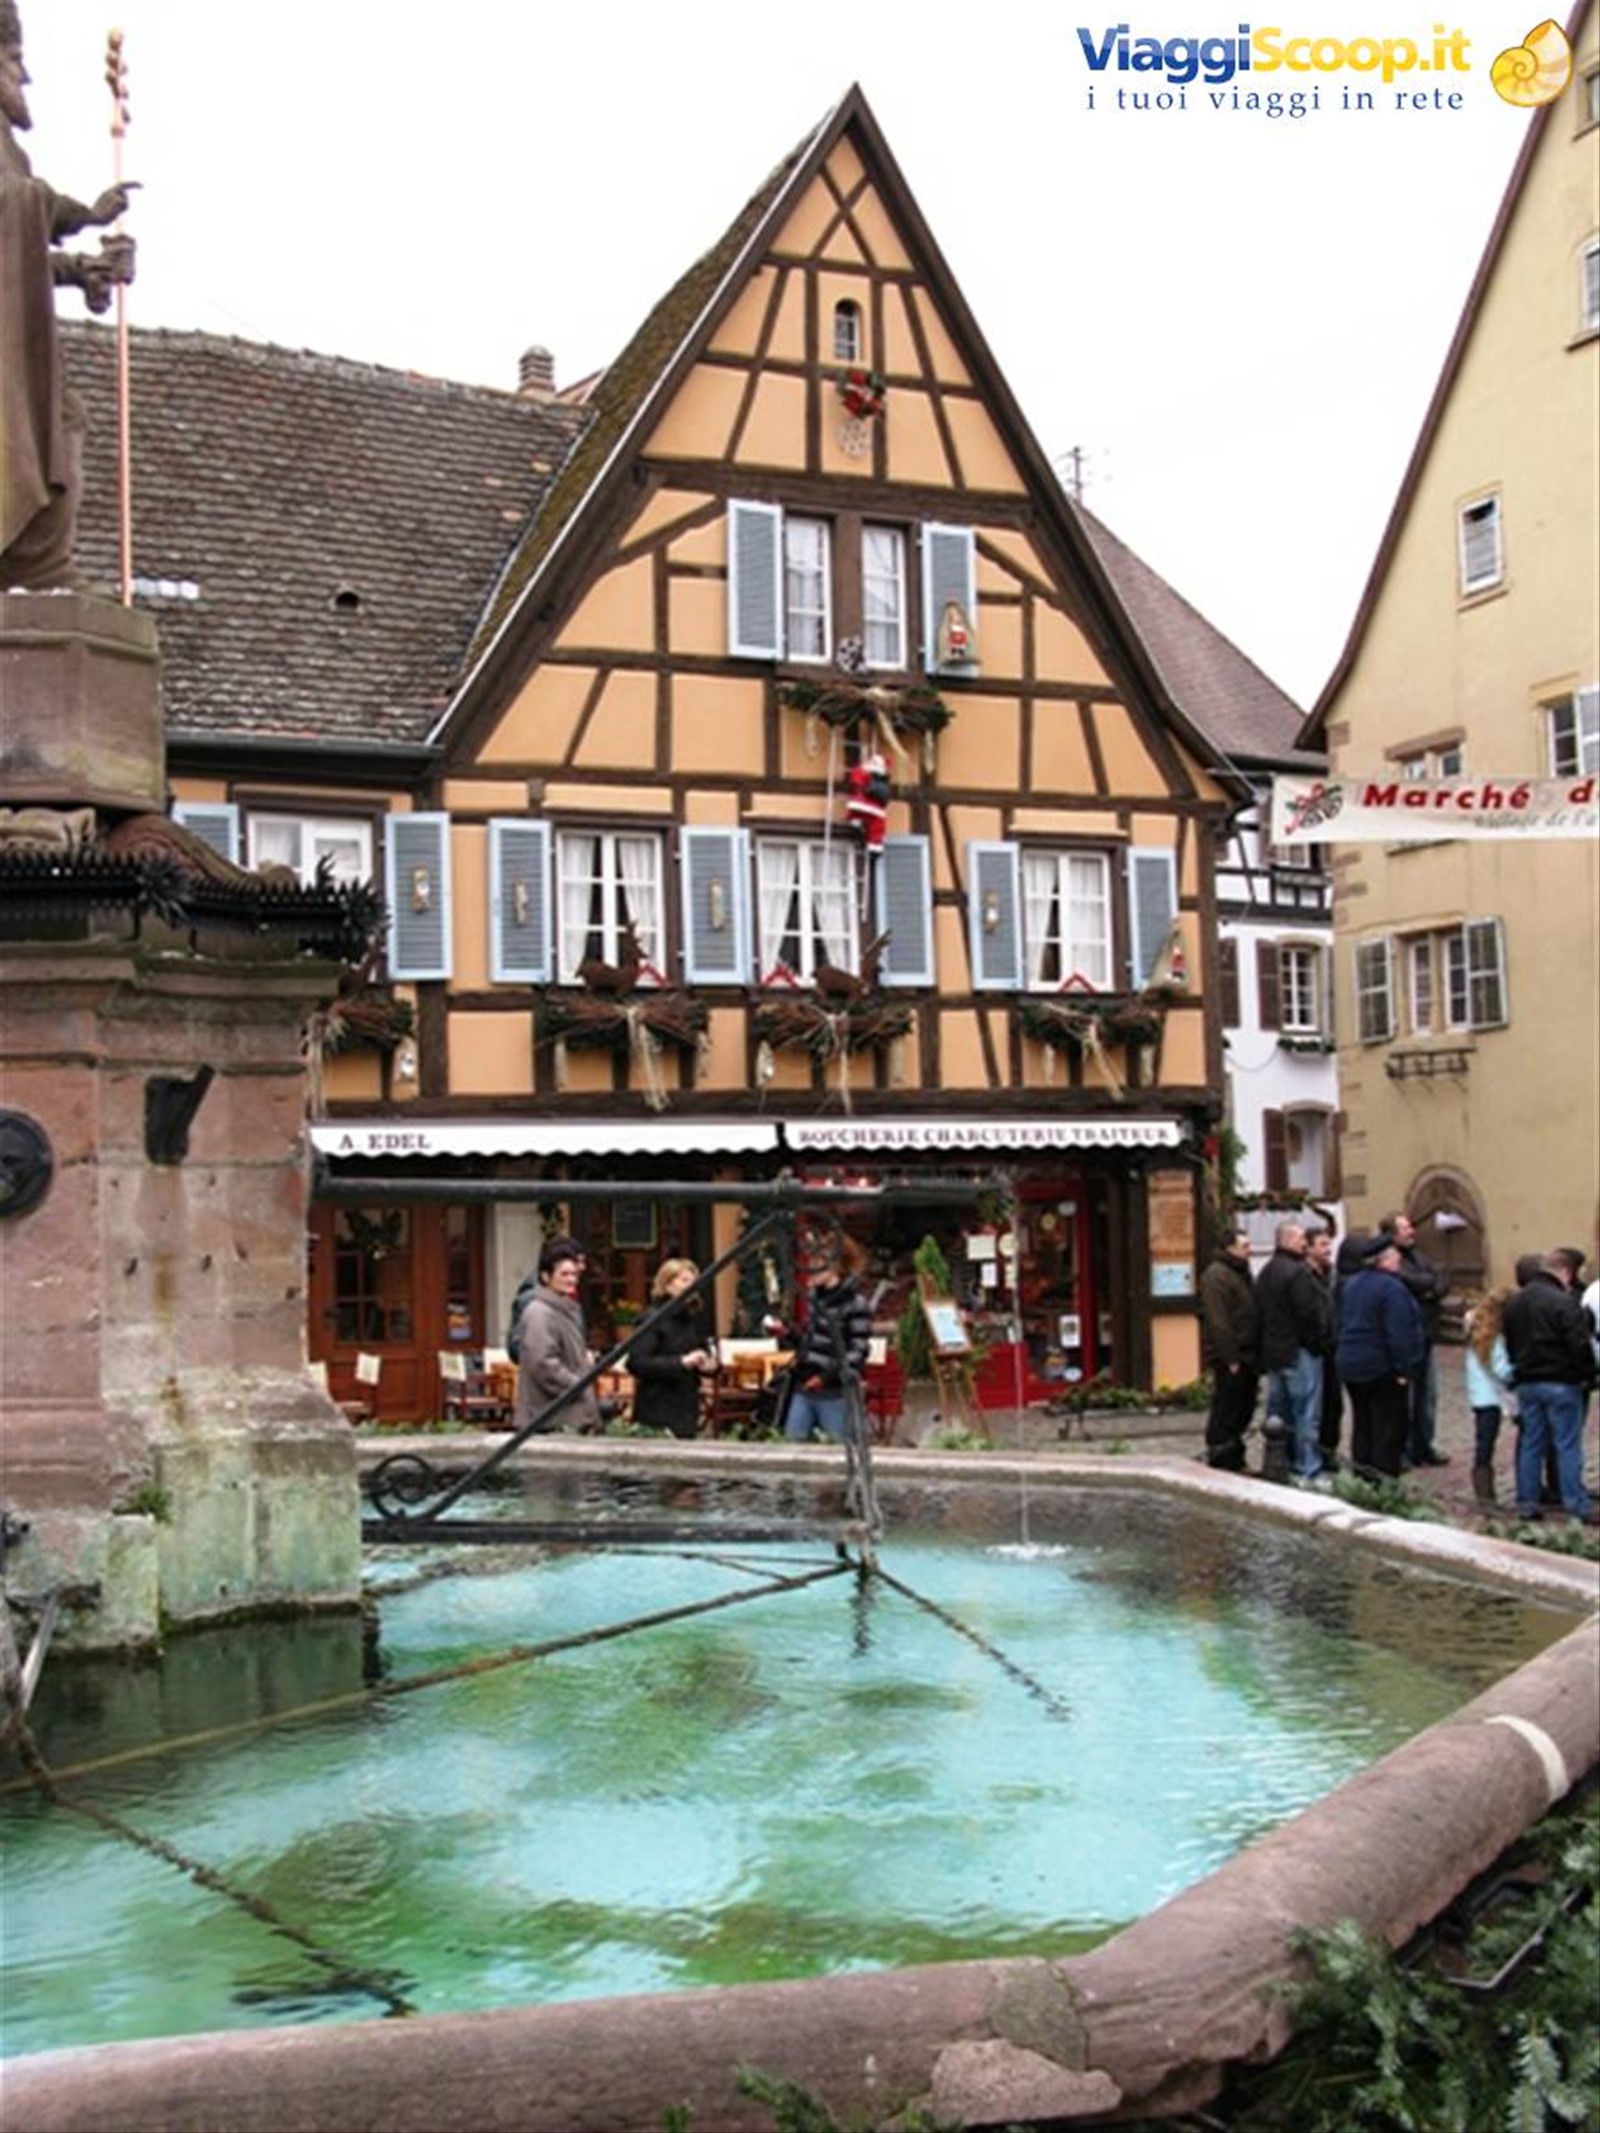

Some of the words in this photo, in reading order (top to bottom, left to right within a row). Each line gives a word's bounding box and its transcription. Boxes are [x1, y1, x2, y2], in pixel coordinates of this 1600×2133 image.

[1363, 783, 1530, 810] Marché
[339, 1133, 354, 1150] A
[367, 1133, 432, 1150] EDEL
[799, 1128, 921, 1144] BOUCHERIE
[923, 1127, 1067, 1143] CHARCUTERIE
[1070, 1127, 1170, 1143] TRAITEUR
